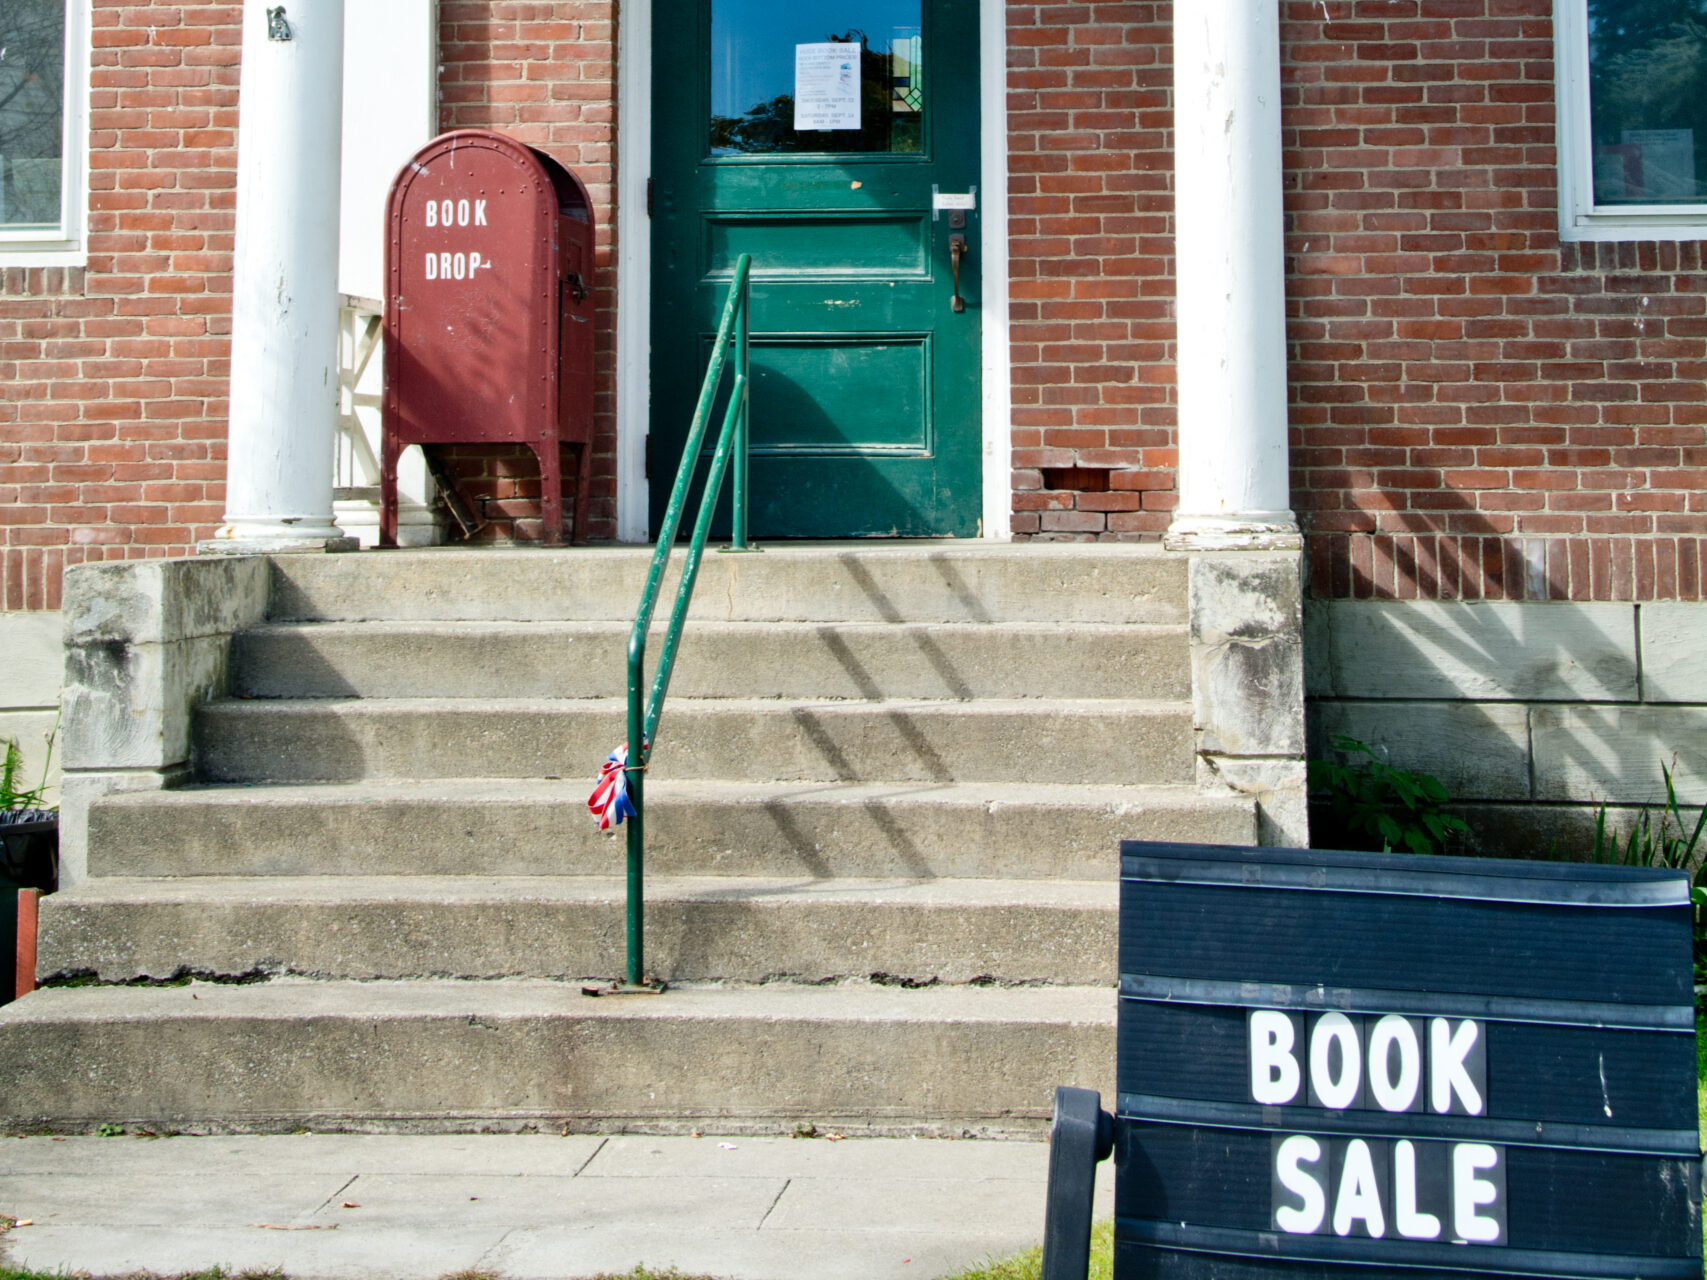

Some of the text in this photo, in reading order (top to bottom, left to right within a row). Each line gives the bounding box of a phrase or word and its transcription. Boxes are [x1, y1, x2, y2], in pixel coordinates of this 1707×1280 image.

[426, 199, 487, 227] BOOK
[425, 251, 482, 280] DROP
[1250, 1010, 1482, 1116] BOOK
[1275, 1134, 1500, 1241] SALE
